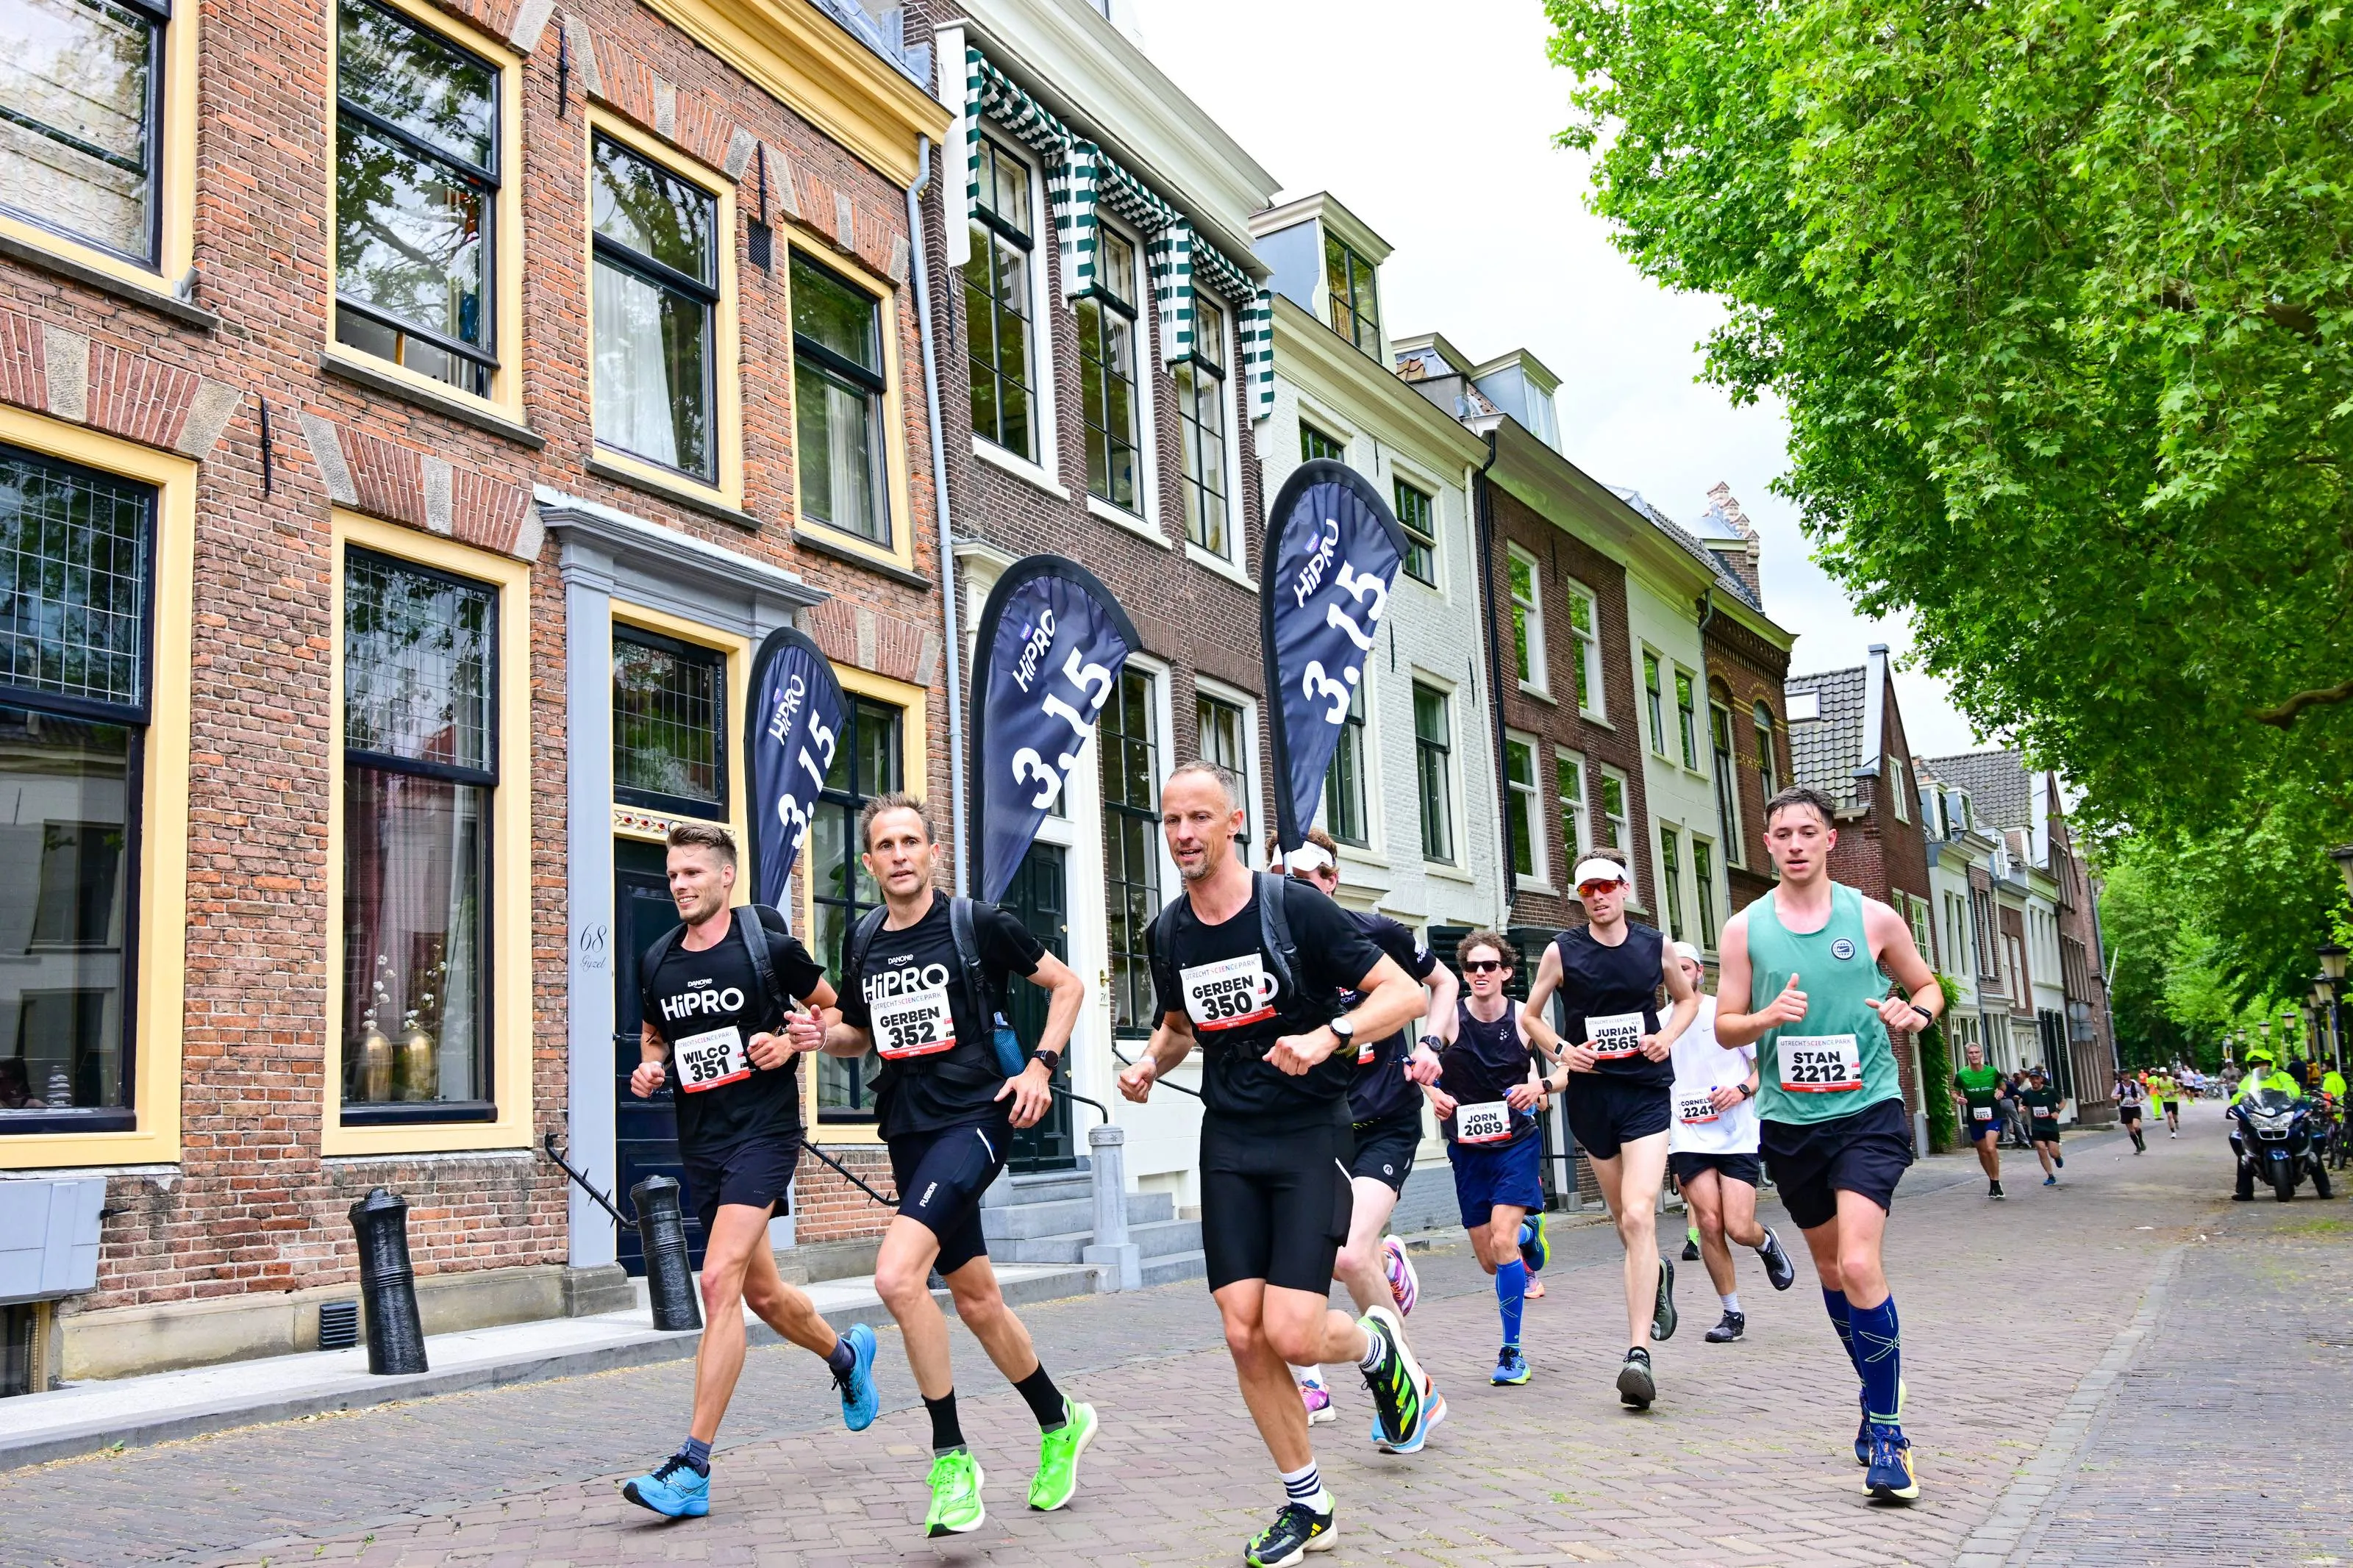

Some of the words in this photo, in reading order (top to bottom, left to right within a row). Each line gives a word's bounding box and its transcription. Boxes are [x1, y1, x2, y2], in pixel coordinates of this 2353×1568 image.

[1013, 609, 1056, 692] HiPRO
[1302, 559, 1388, 725] 3.15
[768, 674, 805, 746] HiPRO
[1012, 647, 1113, 809] 3.15
[778, 709, 835, 850] 3.15
[580, 922, 607, 953] 68
[863, 963, 949, 1003] HiPRO
[1193, 975, 1254, 999] GERBEN
[660, 987, 744, 1021] HiPRO
[880, 1006, 940, 1028] GERBEN
[1202, 991, 1252, 1020] 350
[888, 1022, 937, 1048] 352
[1596, 1025, 1637, 1037] JURIAN
[1597, 1035, 1638, 1051] 2565
[683, 1044, 730, 1064] WILCO
[1793, 1051, 1840, 1064] STAN
[690, 1056, 730, 1082] 351
[1791, 1064, 1846, 1082] 2212
[1468, 1113, 1497, 1123] JORN
[1684, 1105, 1715, 1117] 2241
[1464, 1121, 1503, 1136] 2089
